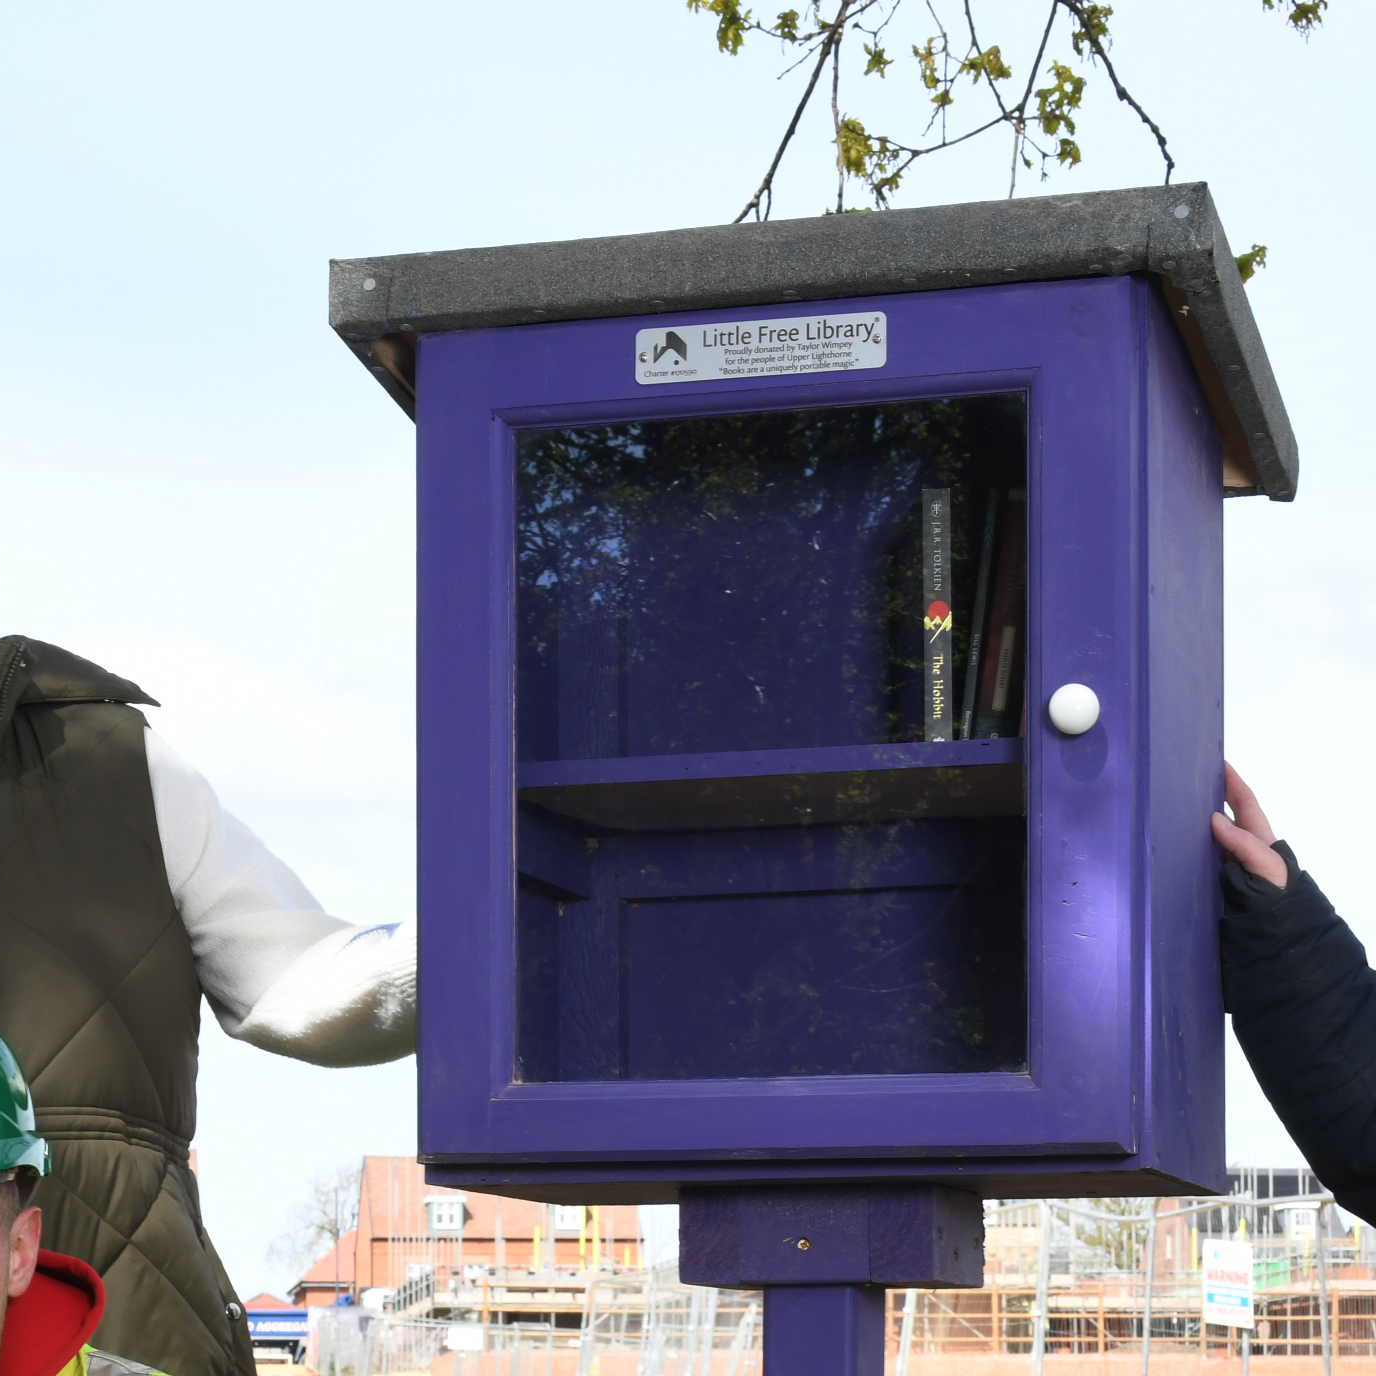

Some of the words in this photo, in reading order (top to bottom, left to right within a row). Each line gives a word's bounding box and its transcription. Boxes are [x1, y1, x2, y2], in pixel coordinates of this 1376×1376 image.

[702, 325, 752, 348] Little
[758, 325, 799, 344] Free
[806, 319, 875, 343] Library
[724, 346, 753, 356] Proudly
[754, 344, 785, 354] donated
[786, 343, 795, 353] by
[796, 341, 820, 352] Taylor
[821, 341, 853, 350] Wimpey
[725, 357, 736, 365] for
[737, 357, 750, 365] the
[751, 354, 776, 365] people
[777, 354, 785, 362] of
[786, 353, 810, 362] Upper
[811, 351, 852, 361] Lighthorne
[644, 369, 670, 378] Charter
[746, 366, 759, 374] are
[765, 363, 798, 373] uniquely
[799, 360, 831, 372] portable
[930, 521, 942, 546] J.R.R.
[933, 548, 942, 591] TOLKIEN
[932, 653, 944, 675] The
[970, 647, 978, 666] LEWIS
[932, 679, 945, 719] Hobbit
[963, 710, 971, 737] Barrington
[255, 1321, 309, 1332] AGGREGA
